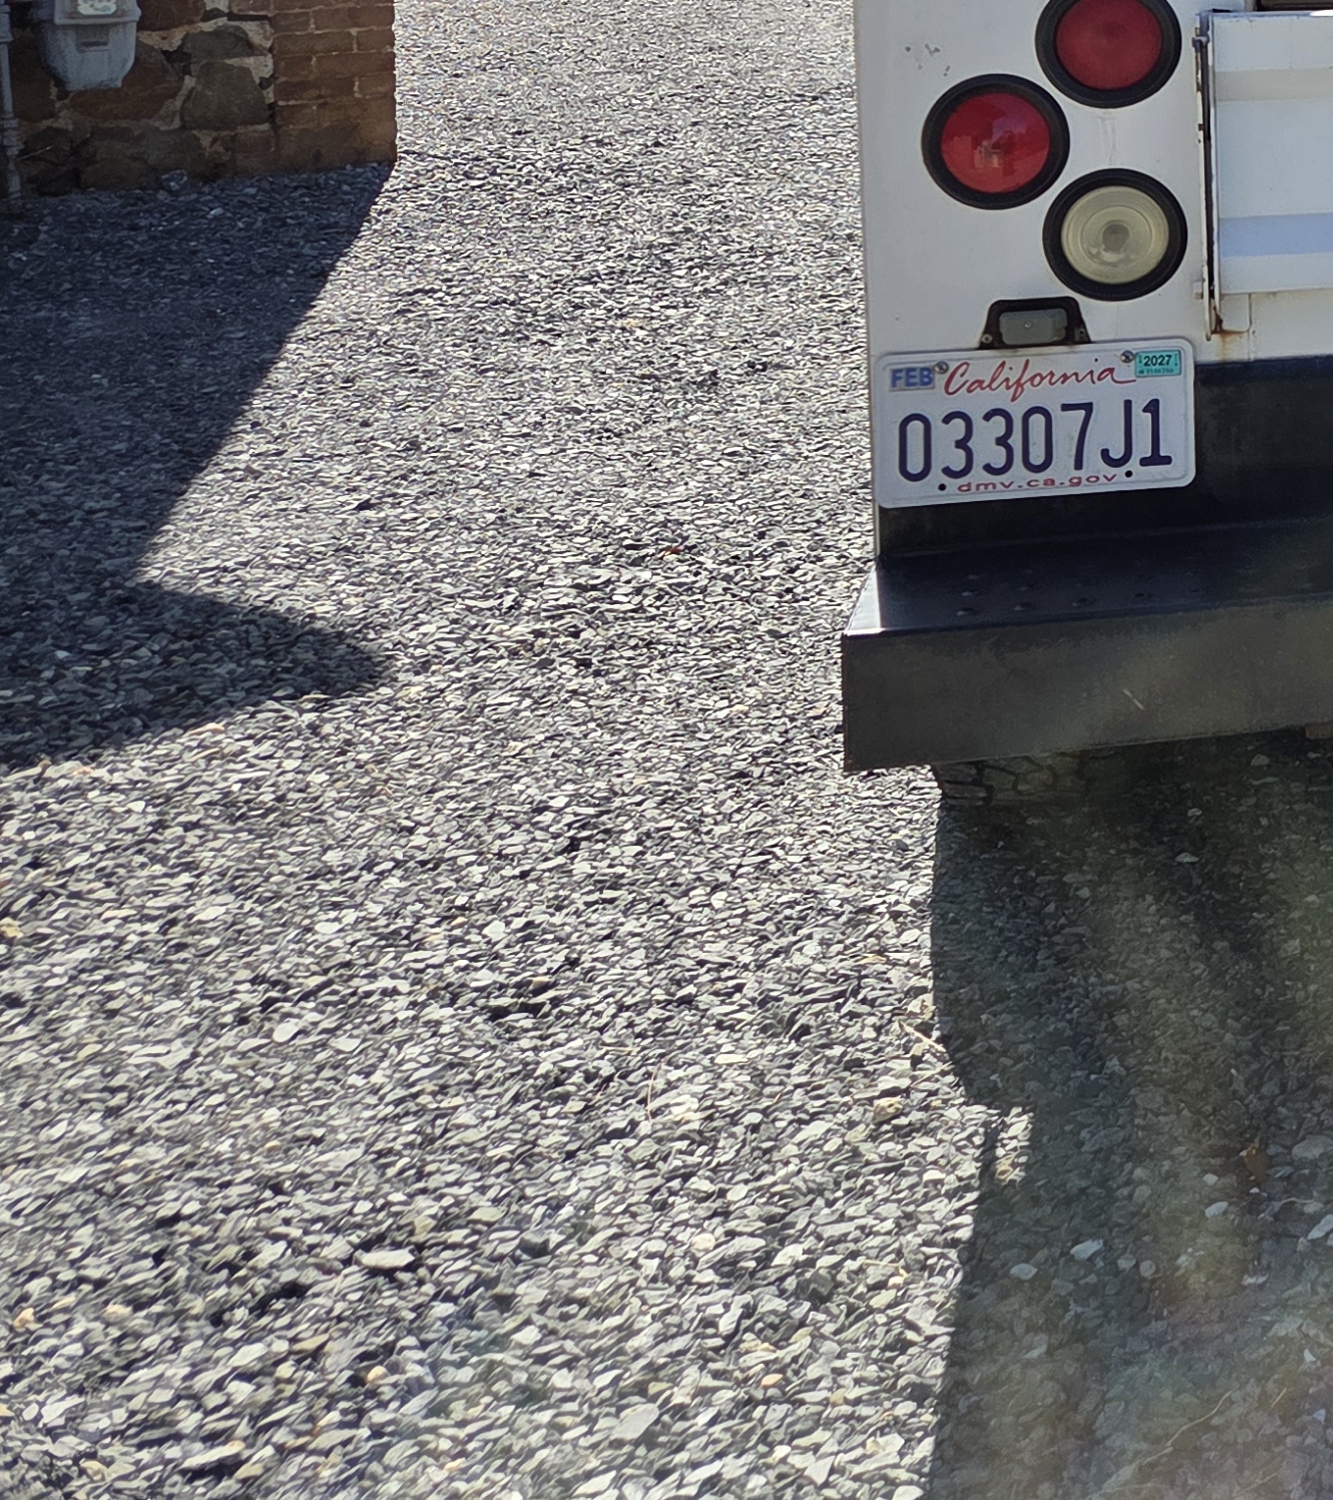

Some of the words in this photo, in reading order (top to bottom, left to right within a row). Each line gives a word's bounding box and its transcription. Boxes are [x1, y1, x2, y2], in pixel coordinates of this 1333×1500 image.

[1142, 354, 1173, 367] 2027
[890, 366, 935, 389] FEB
[943, 358, 1137, 403] California
[898, 397, 1173, 483] 03307J1
[956, 472, 1118, 493] dmv.ca.gov
